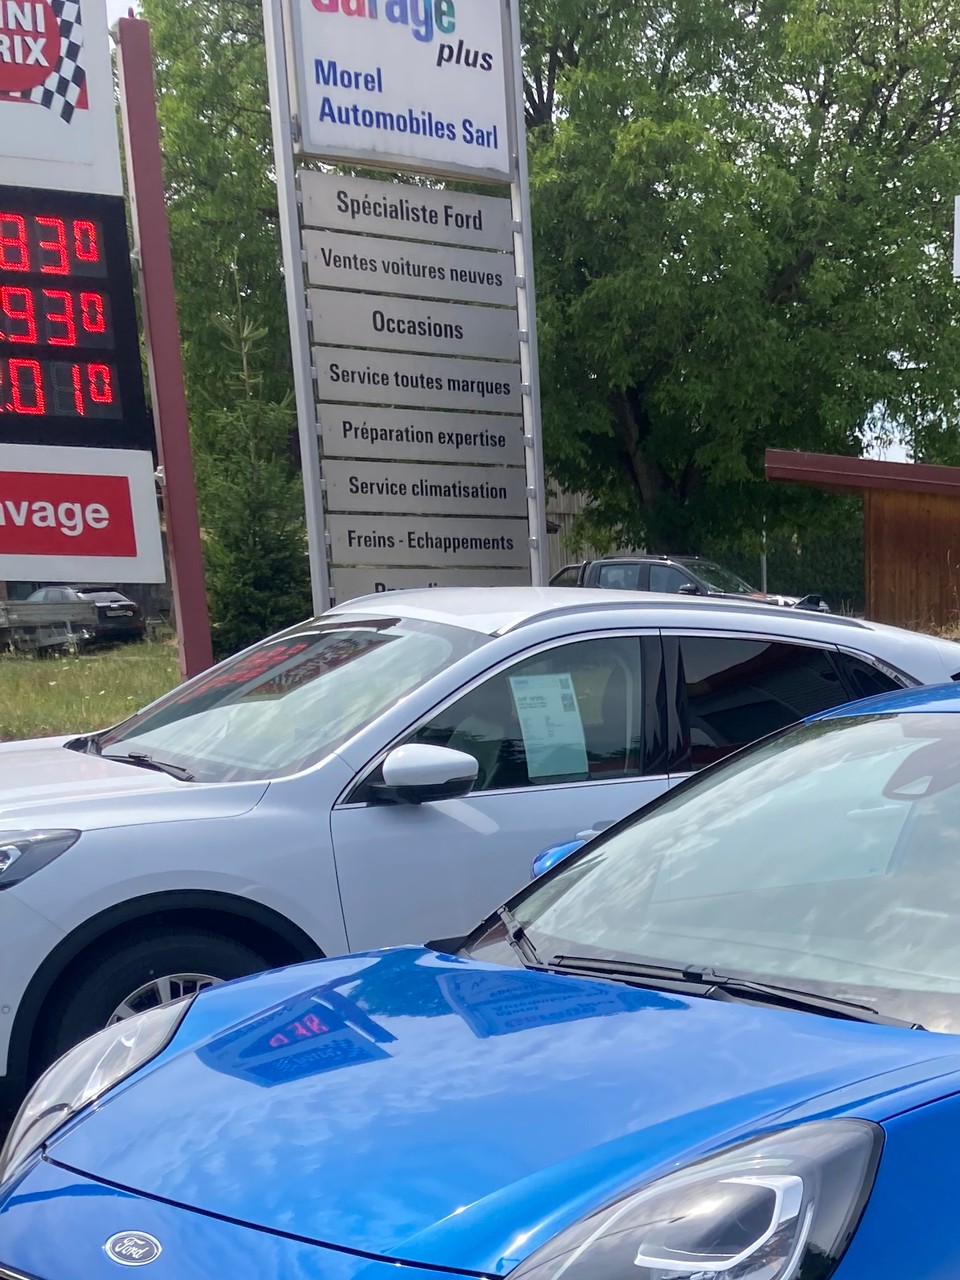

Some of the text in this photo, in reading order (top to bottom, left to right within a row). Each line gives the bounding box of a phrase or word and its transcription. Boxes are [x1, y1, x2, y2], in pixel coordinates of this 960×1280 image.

[436, 39, 494, 71] plus
[314, 58, 383, 93] Morel
[319, 96, 499, 149] Automobiles Sarl
[336, 189, 483, 231] Spécialiste Ford
[320, 247, 503, 287] Ventes voitures neuves
[372, 310, 464, 340] Occasions
[329, 363, 511, 398] Service toutes marques
[342, 420, 506, 449] Préparation expertise
[349, 476, 507, 500] Service climatisation
[0, 499, 110, 537] vage
[347, 530, 395, 548] Freins
[407, 531, 514, 553] Echappements
[114, 1236, 150, 1259] Ford
